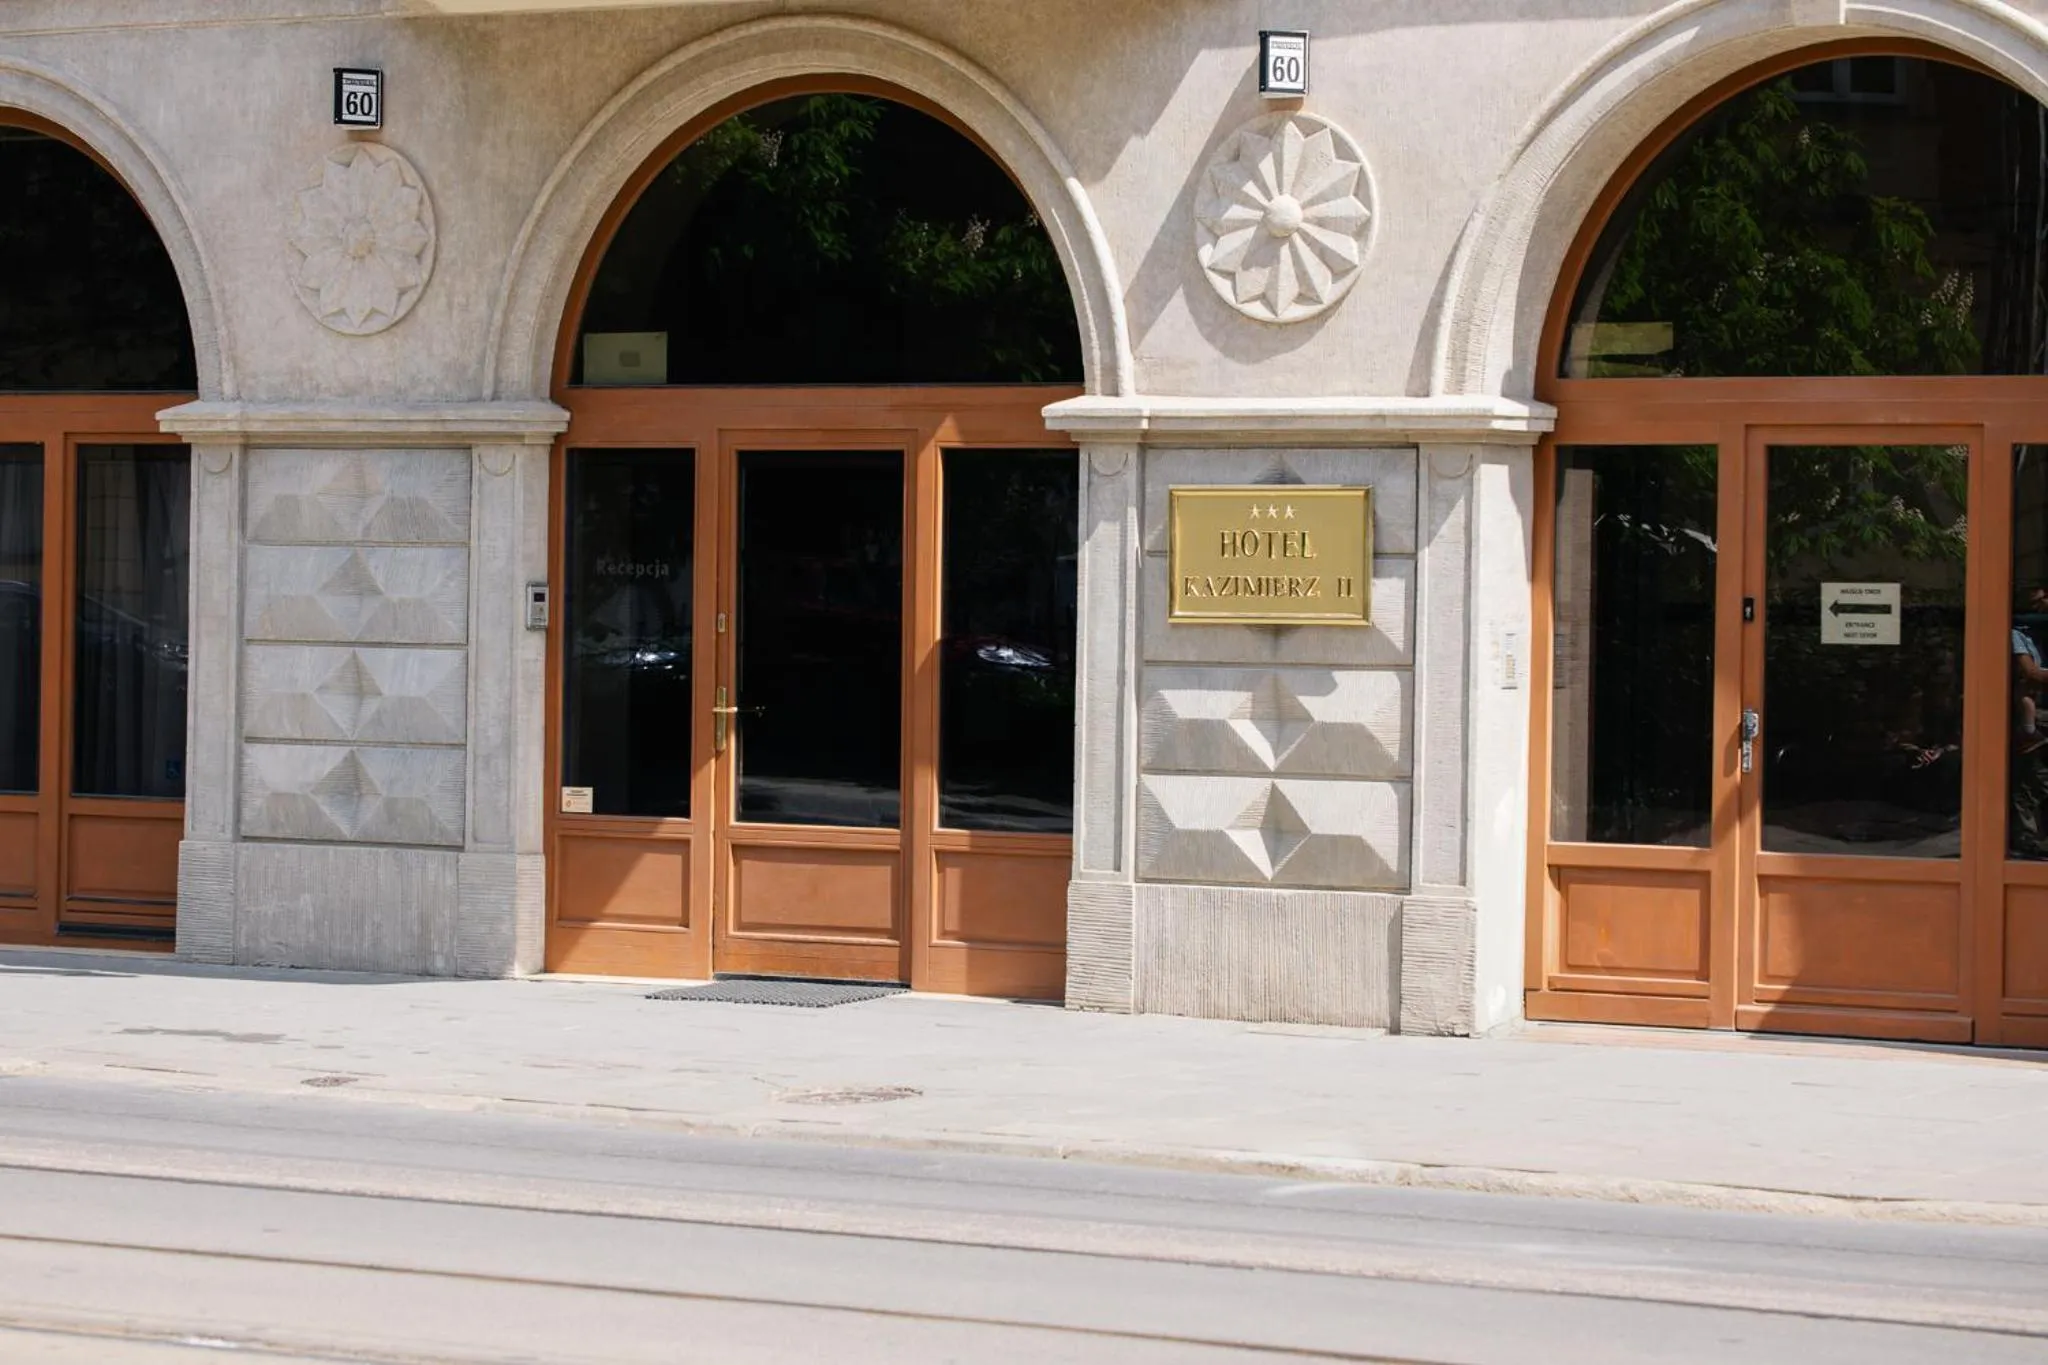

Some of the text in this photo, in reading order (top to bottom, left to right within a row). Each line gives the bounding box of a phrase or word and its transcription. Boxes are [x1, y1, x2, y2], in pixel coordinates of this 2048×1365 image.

[1273, 55, 1300, 83] 60
[346, 91, 373, 116] 60
[1220, 529, 1317, 559] HOTEL
[596, 558, 669, 579] Recepcja
[1184, 575, 1355, 598] KAZIMIERZ II
